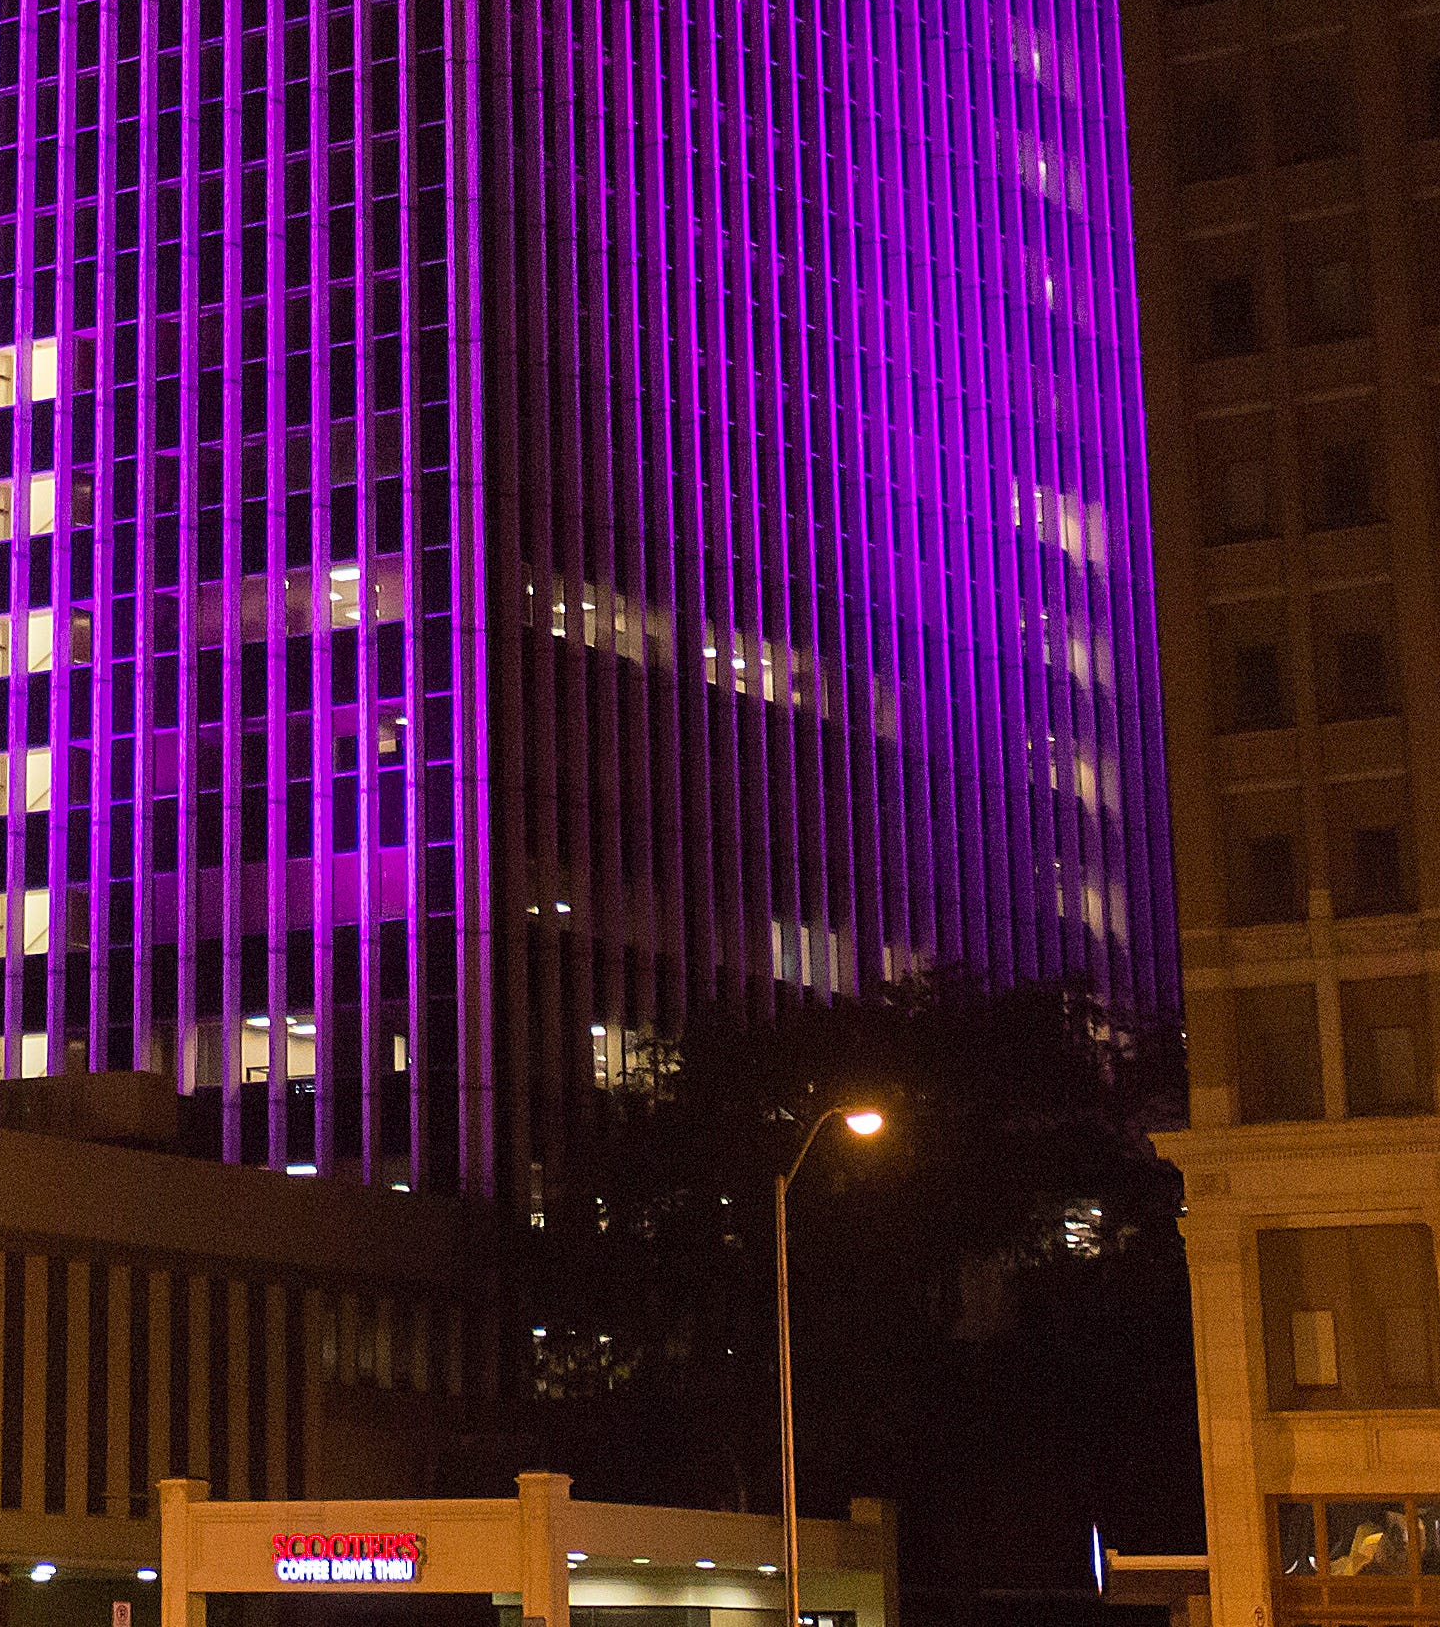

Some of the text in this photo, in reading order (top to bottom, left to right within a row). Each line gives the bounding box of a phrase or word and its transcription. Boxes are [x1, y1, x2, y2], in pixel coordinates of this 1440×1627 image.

[272, 1533, 418, 1561] SCOOTER'S
[277, 1558, 413, 1580] COFFEE DRIVE THRU
